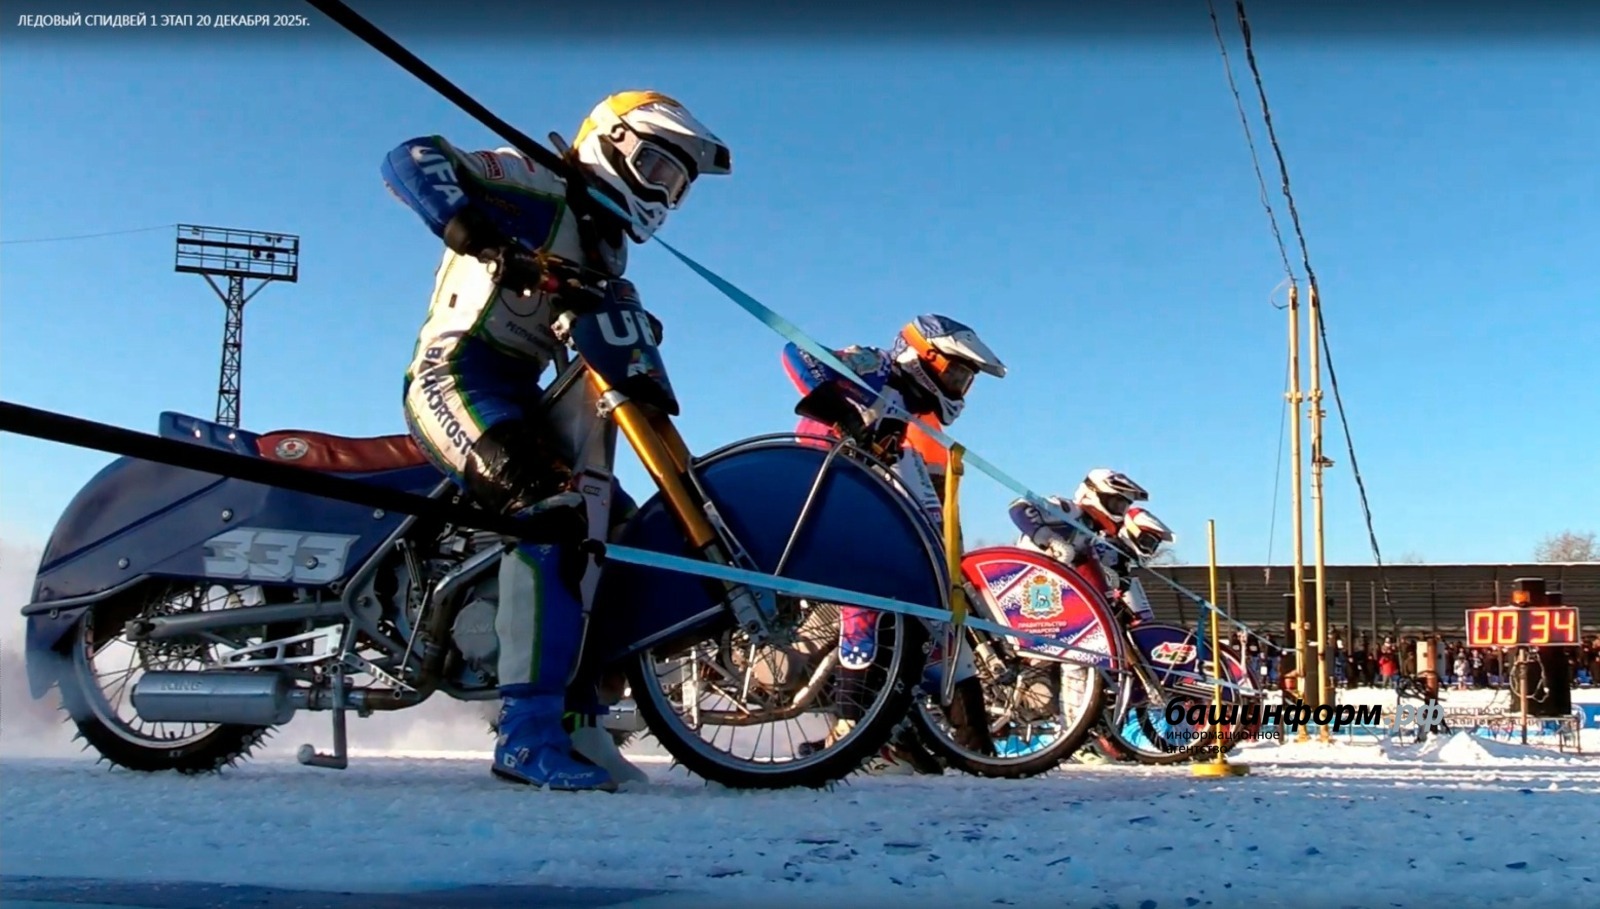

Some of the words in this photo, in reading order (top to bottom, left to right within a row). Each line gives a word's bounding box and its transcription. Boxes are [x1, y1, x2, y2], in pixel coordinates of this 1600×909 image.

[202, 526, 361, 584] 333
[1473, 611, 1519, 644] 00
[1530, 610, 1575, 644] 34
